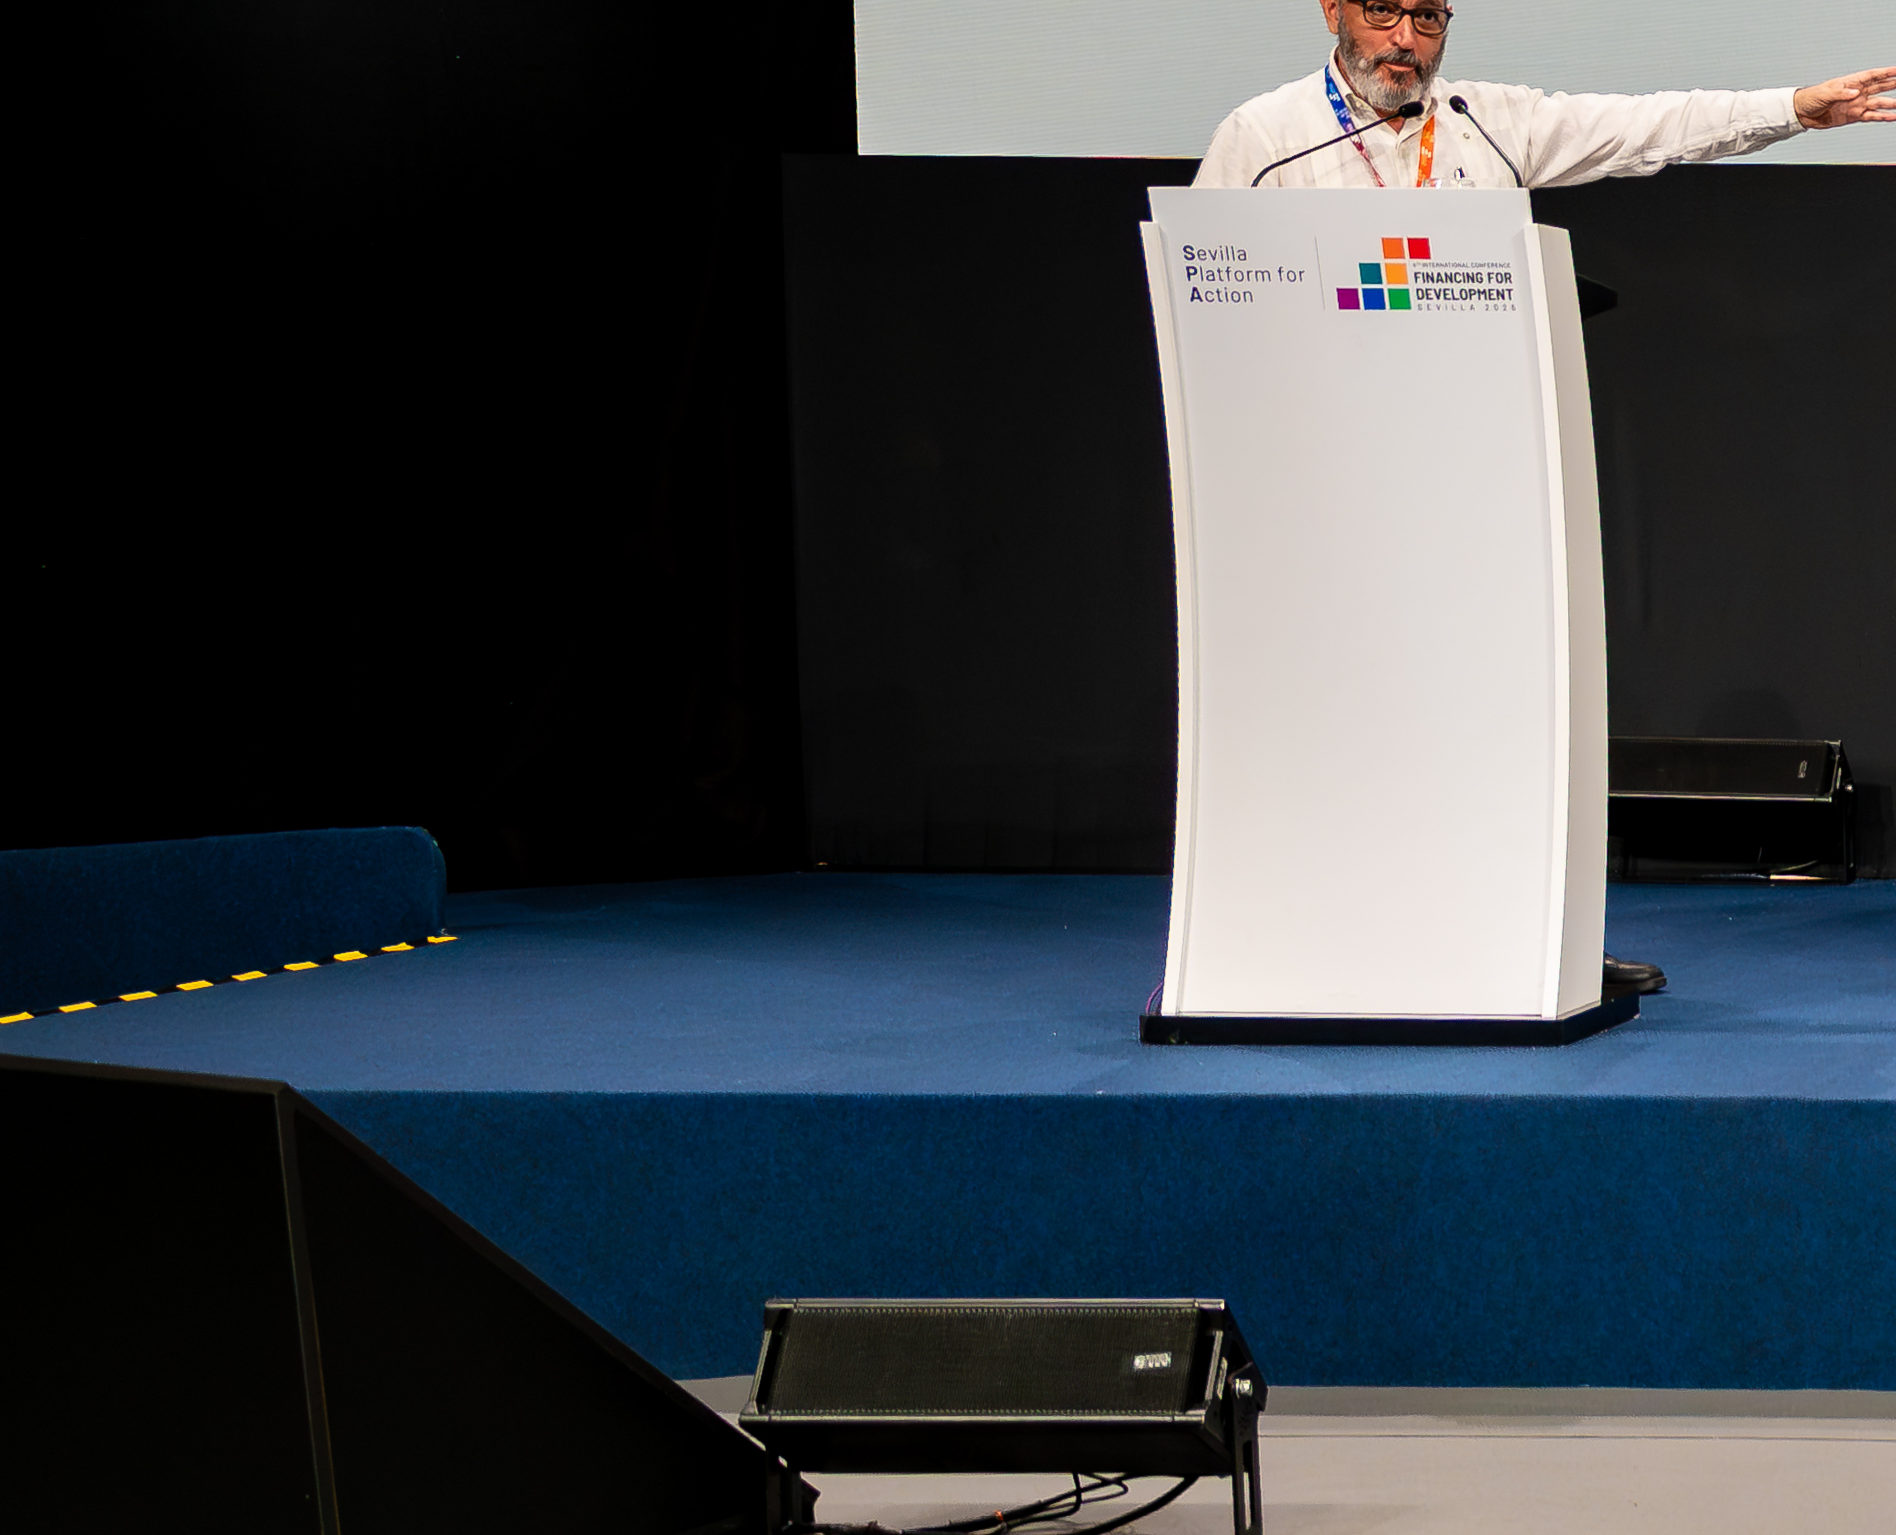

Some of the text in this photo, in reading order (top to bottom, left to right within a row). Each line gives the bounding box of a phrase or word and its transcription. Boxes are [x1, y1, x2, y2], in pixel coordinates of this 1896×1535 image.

[1182, 244, 1247, 262] Sevilla
[1185, 265, 1306, 283] Platform for
[1413, 271, 1513, 284] FINANCING FOR
[1189, 286, 1254, 303] Action
[1415, 287, 1514, 301] DEVELOPMENT
[1417, 303, 1476, 312] SEVILLA
